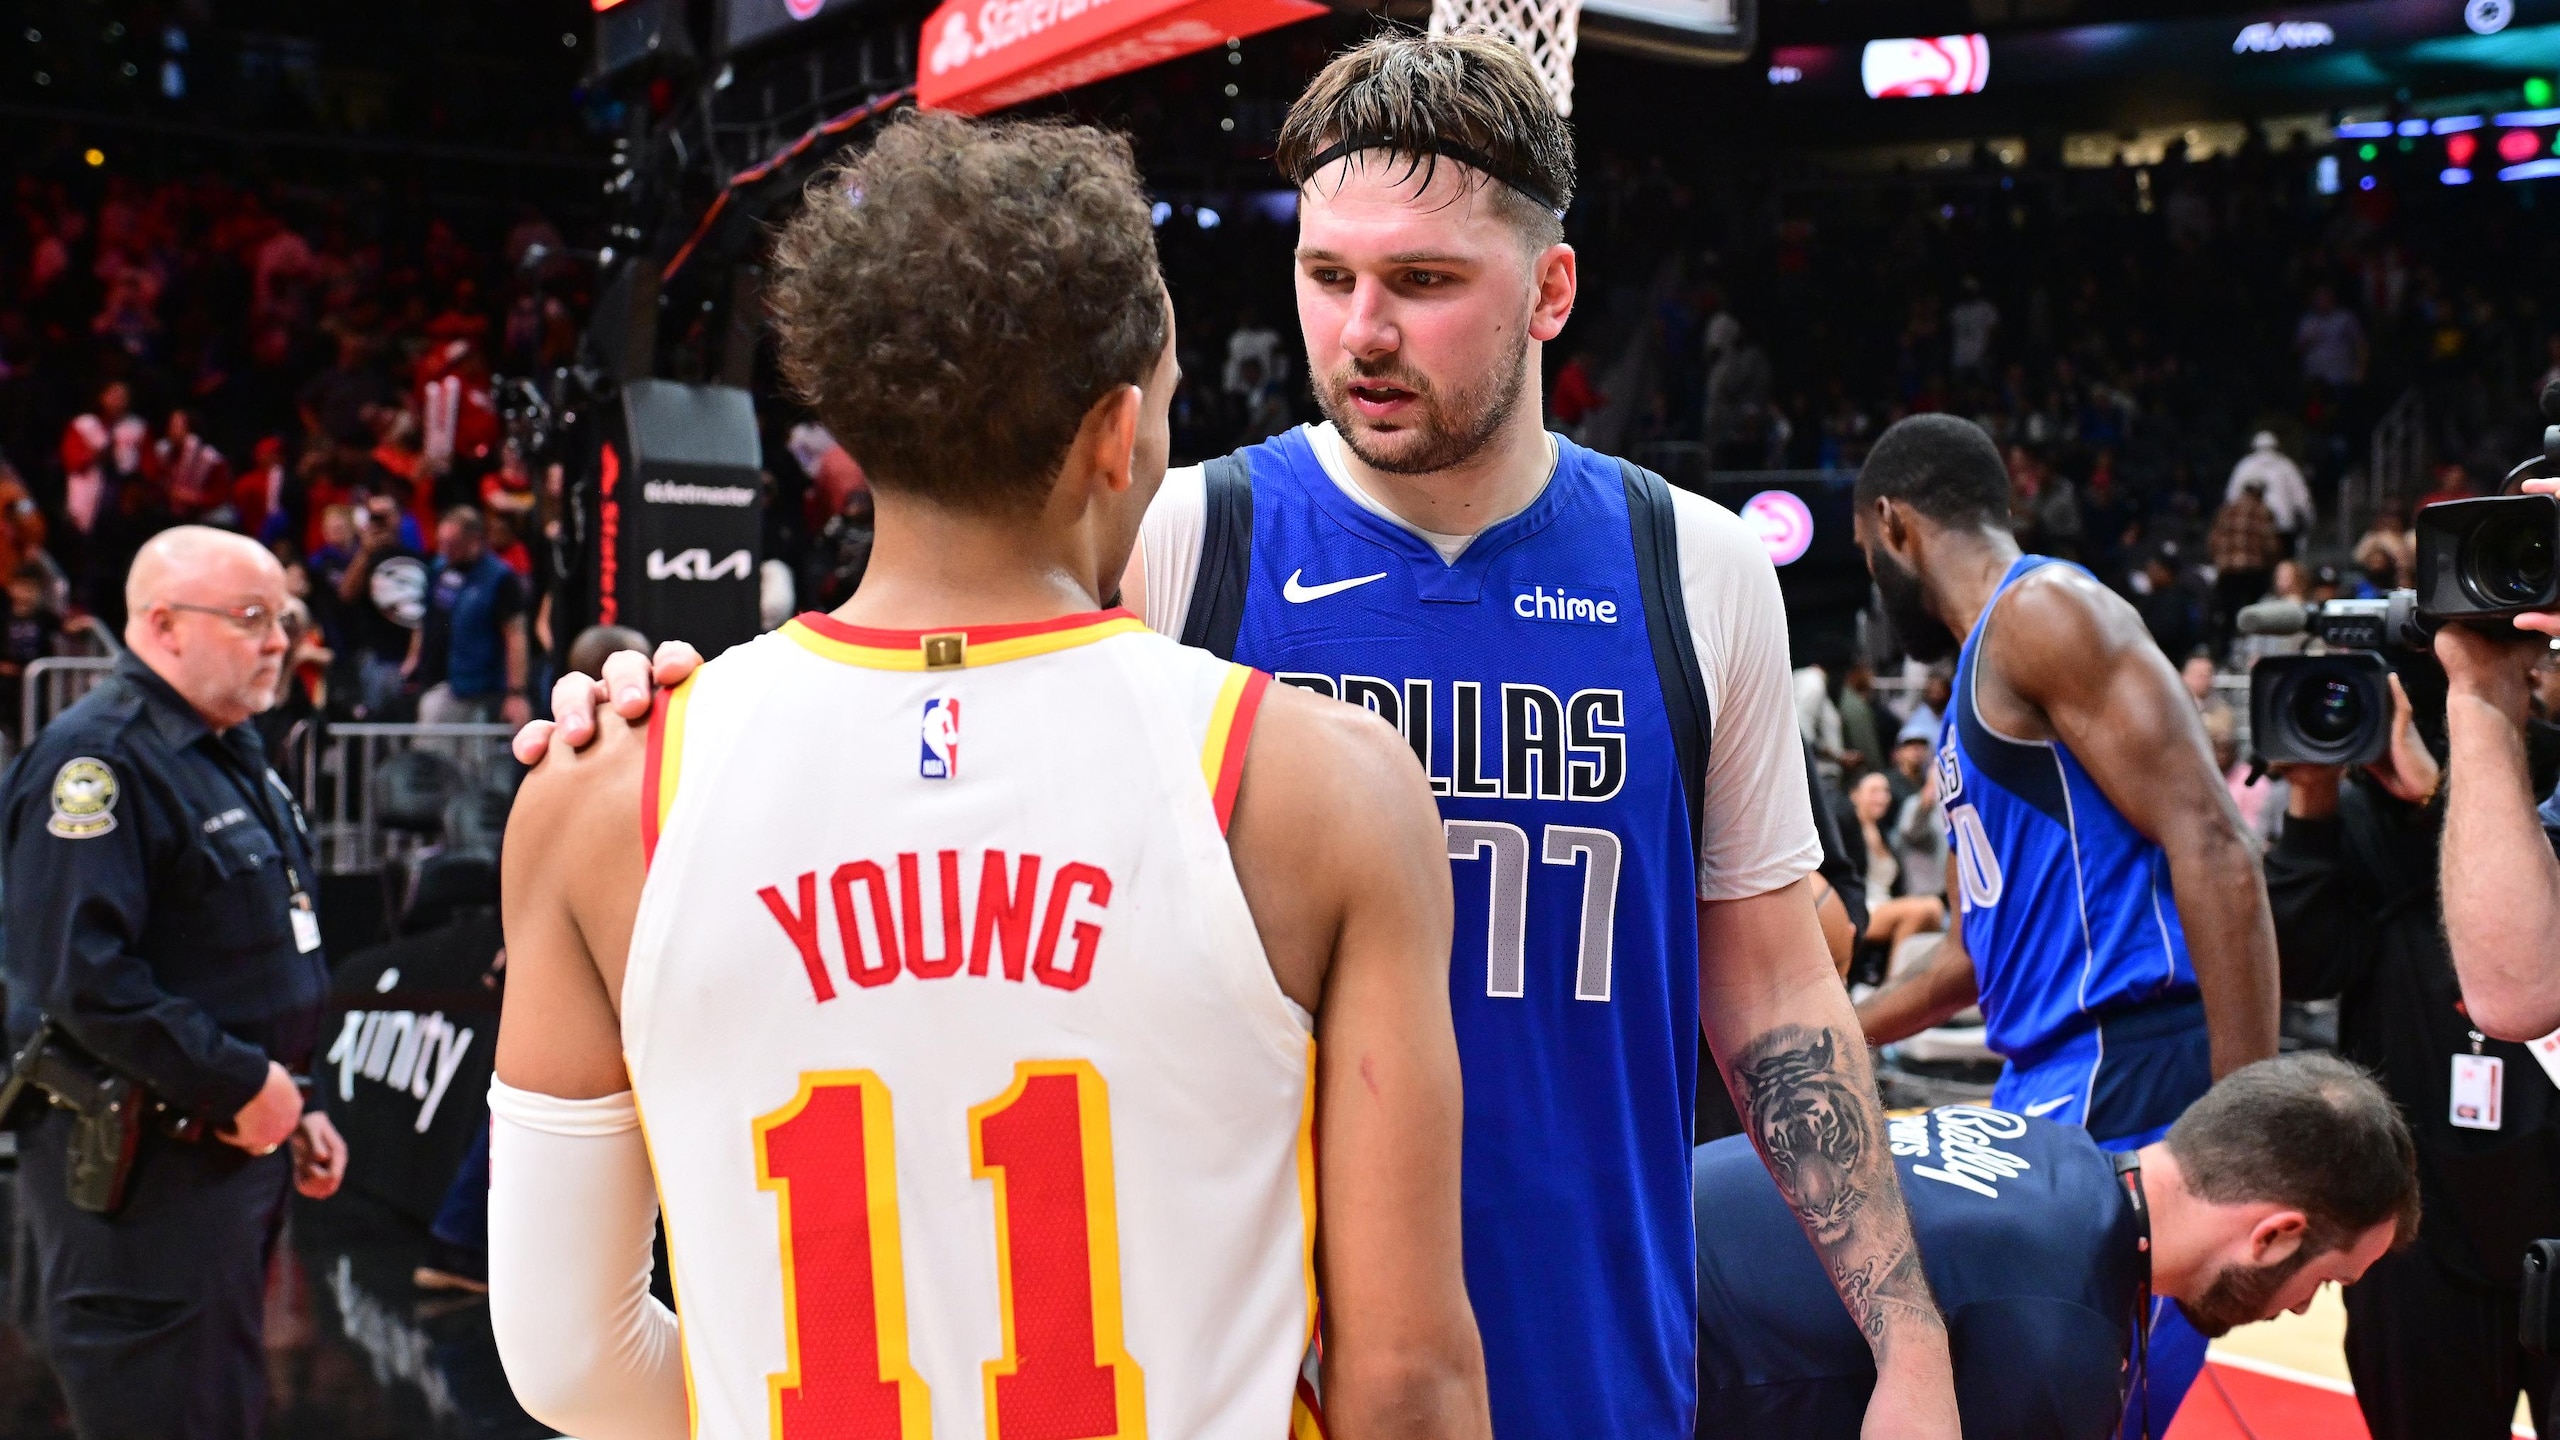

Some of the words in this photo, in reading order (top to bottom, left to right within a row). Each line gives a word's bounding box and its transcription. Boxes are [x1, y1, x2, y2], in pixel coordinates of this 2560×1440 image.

[646, 548, 752, 581] KIA
[1513, 585, 1618, 624] chime
[1274, 671, 1628, 802] LLAS
[757, 848, 1113, 1004] YOUNG
[1442, 818, 1623, 1002] 77
[1912, 1104, 2031, 1198] Bally
[751, 1058, 1149, 1440] 11
